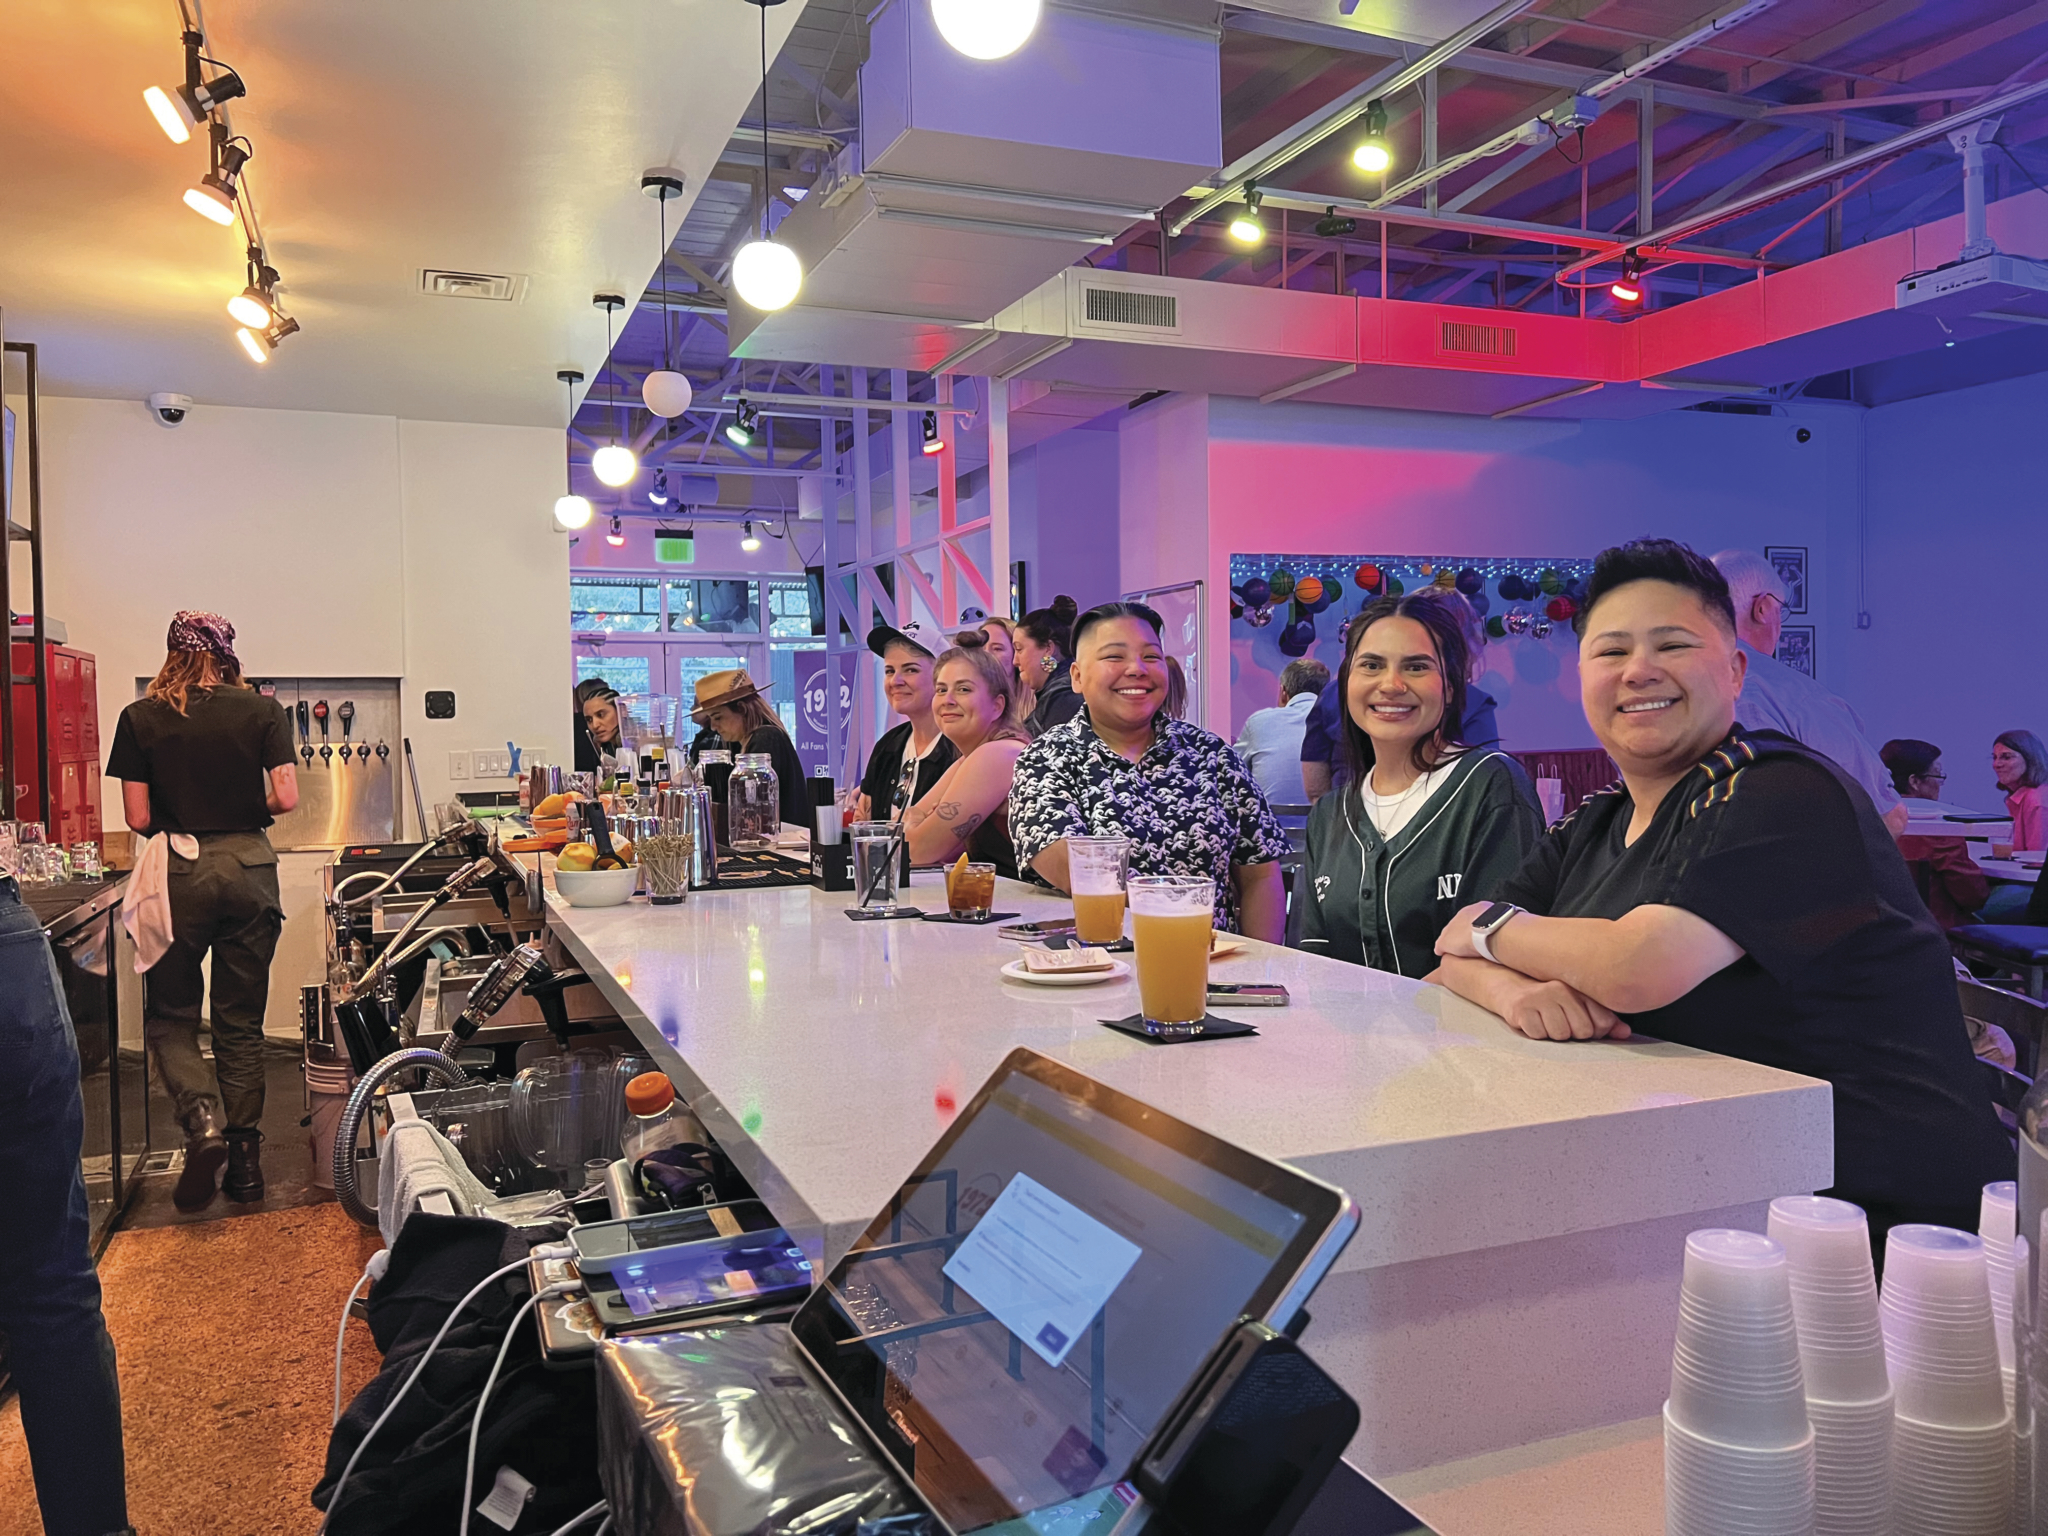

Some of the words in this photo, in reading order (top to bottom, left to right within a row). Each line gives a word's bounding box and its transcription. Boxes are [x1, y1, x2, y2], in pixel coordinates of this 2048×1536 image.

[803, 685, 850, 713] 192
[801, 741, 809, 750] All
[810, 741, 824, 750] Fans
